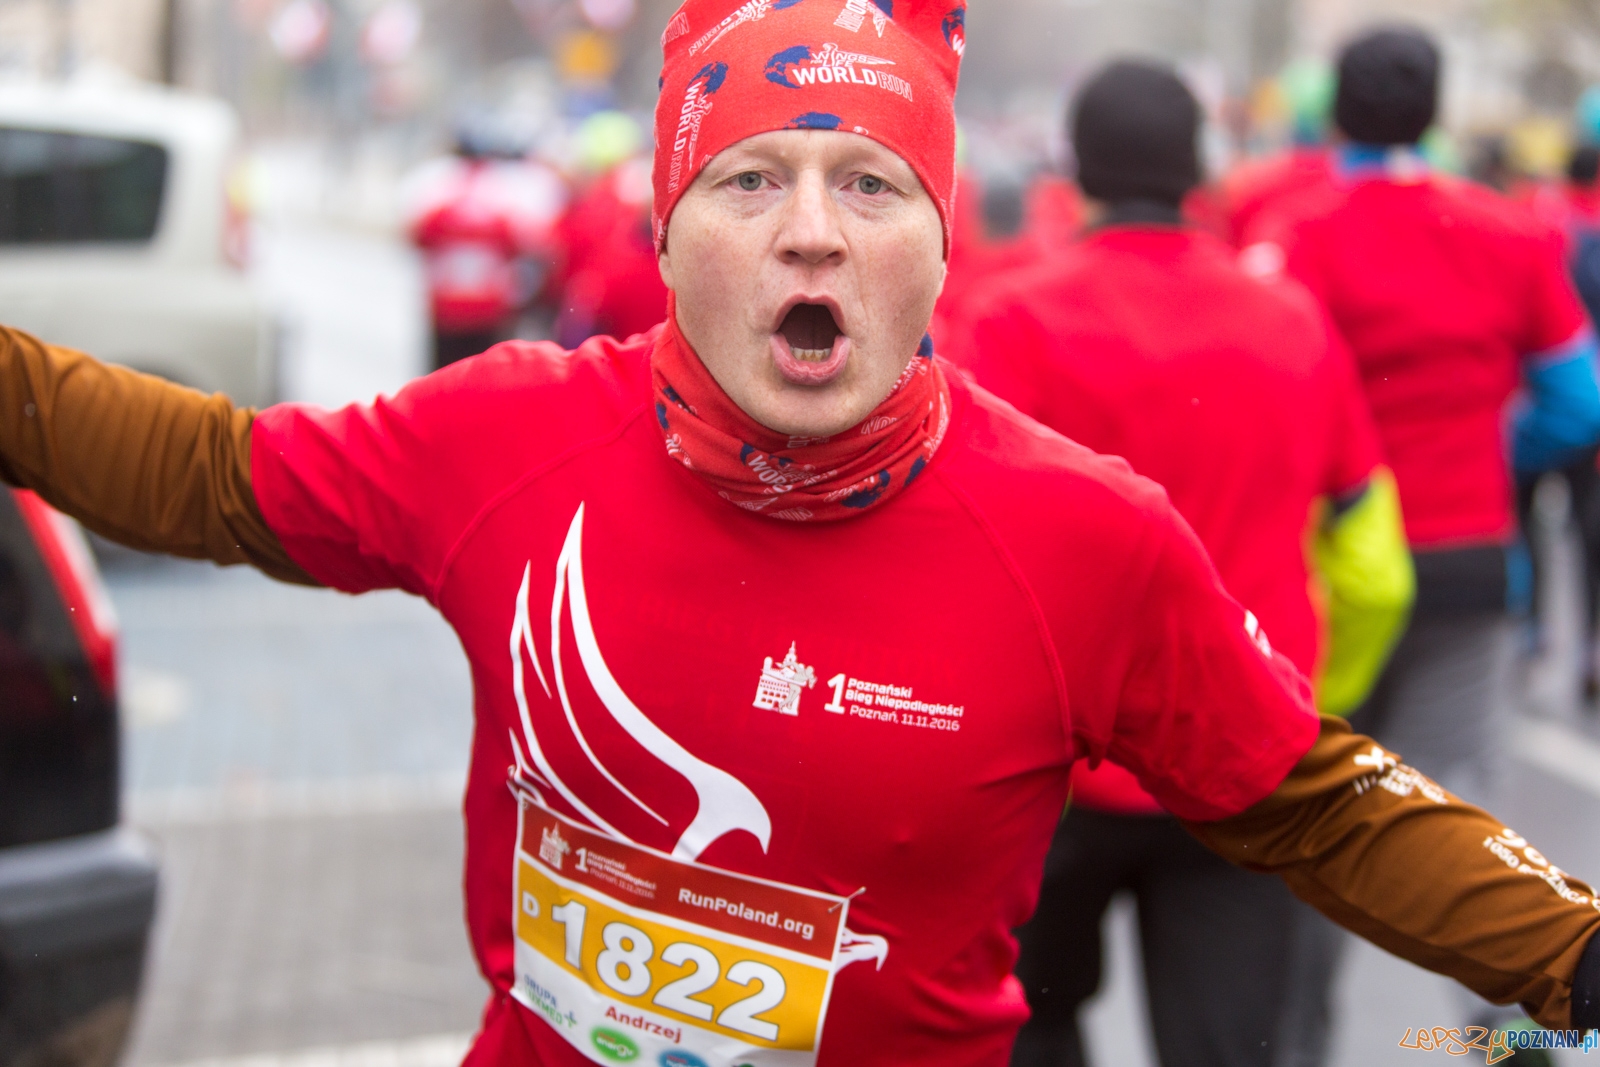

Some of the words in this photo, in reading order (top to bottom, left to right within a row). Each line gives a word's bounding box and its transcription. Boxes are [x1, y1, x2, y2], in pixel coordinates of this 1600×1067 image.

[824, 673, 846, 714] 1
[845, 689, 872, 705] Bieg
[875, 696, 964, 718] Niepodległości
[848, 678, 912, 698] Poznański
[849, 705, 899, 724] Poznań,
[901, 713, 960, 732] 11.11.2016
[575, 847, 589, 873] 1
[678, 888, 814, 941] RunPoland.org
[522, 890, 541, 918] D
[551, 899, 787, 1042] 1822
[604, 1005, 683, 1044] Andrzej
